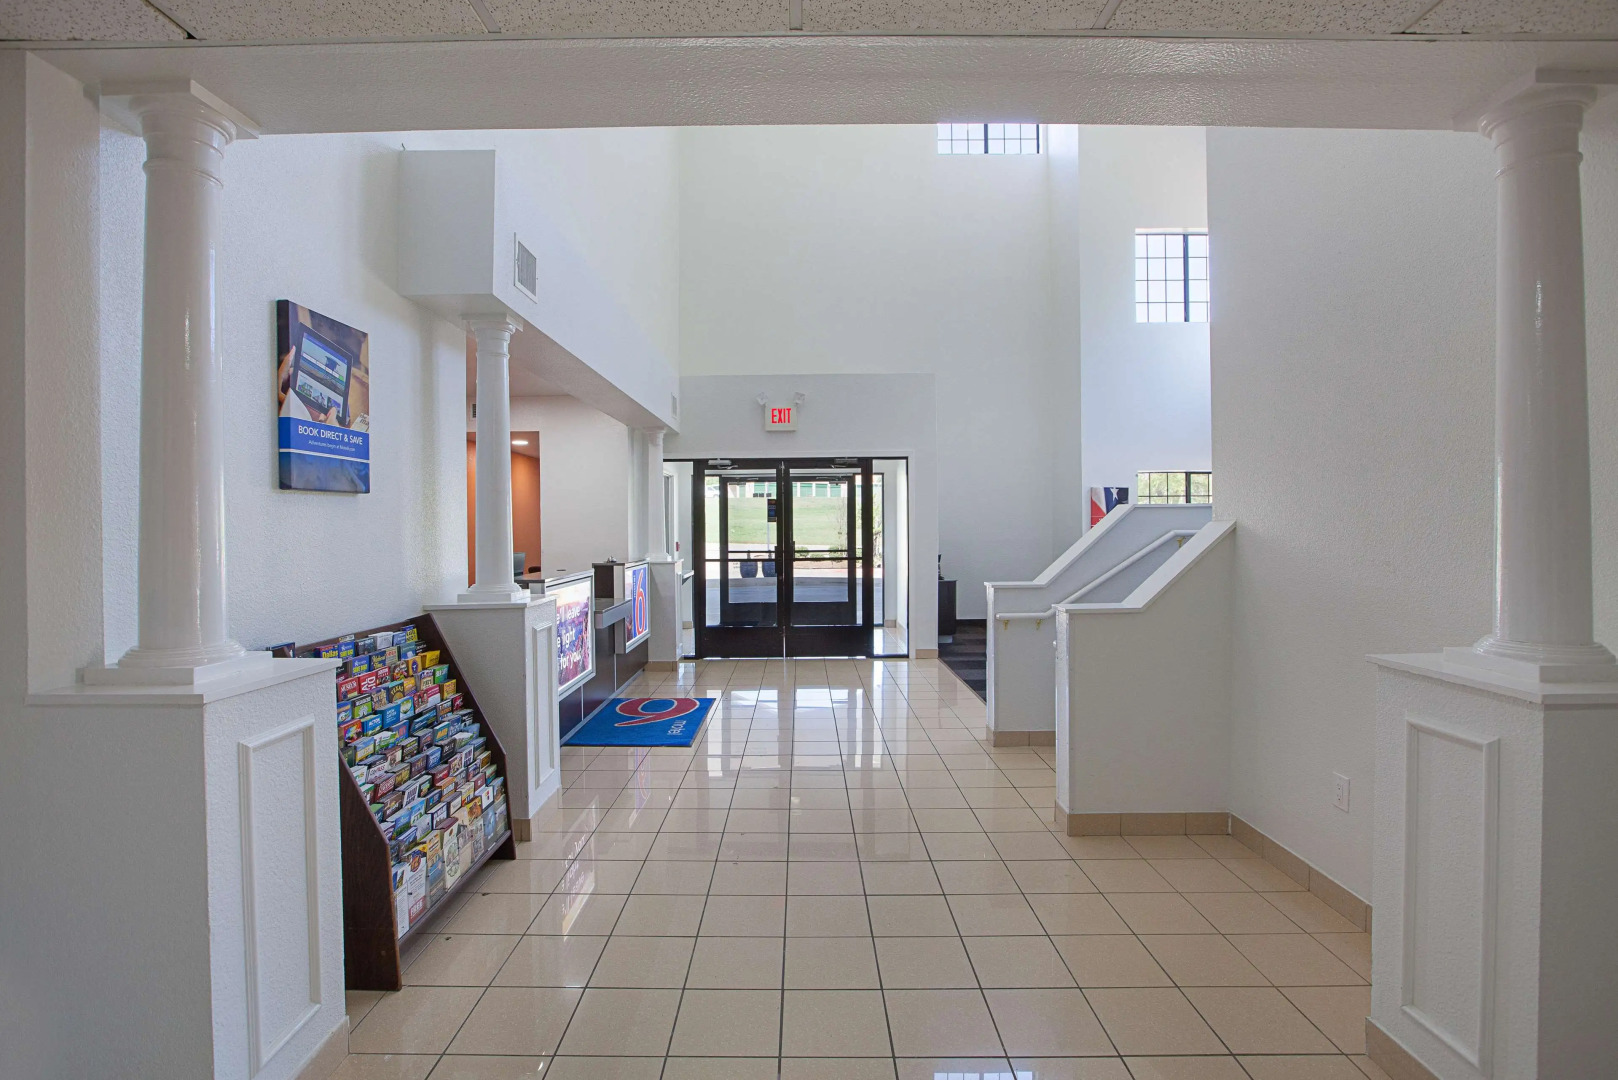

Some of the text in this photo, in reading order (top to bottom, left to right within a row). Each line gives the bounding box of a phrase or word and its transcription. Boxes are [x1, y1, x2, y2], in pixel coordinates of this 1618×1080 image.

[771, 407, 792, 424] EXIT
[298, 425, 363, 445] BOOK DIRECT & SAVE
[560, 652, 569, 670] for
[410, 898, 423, 916] FREE
